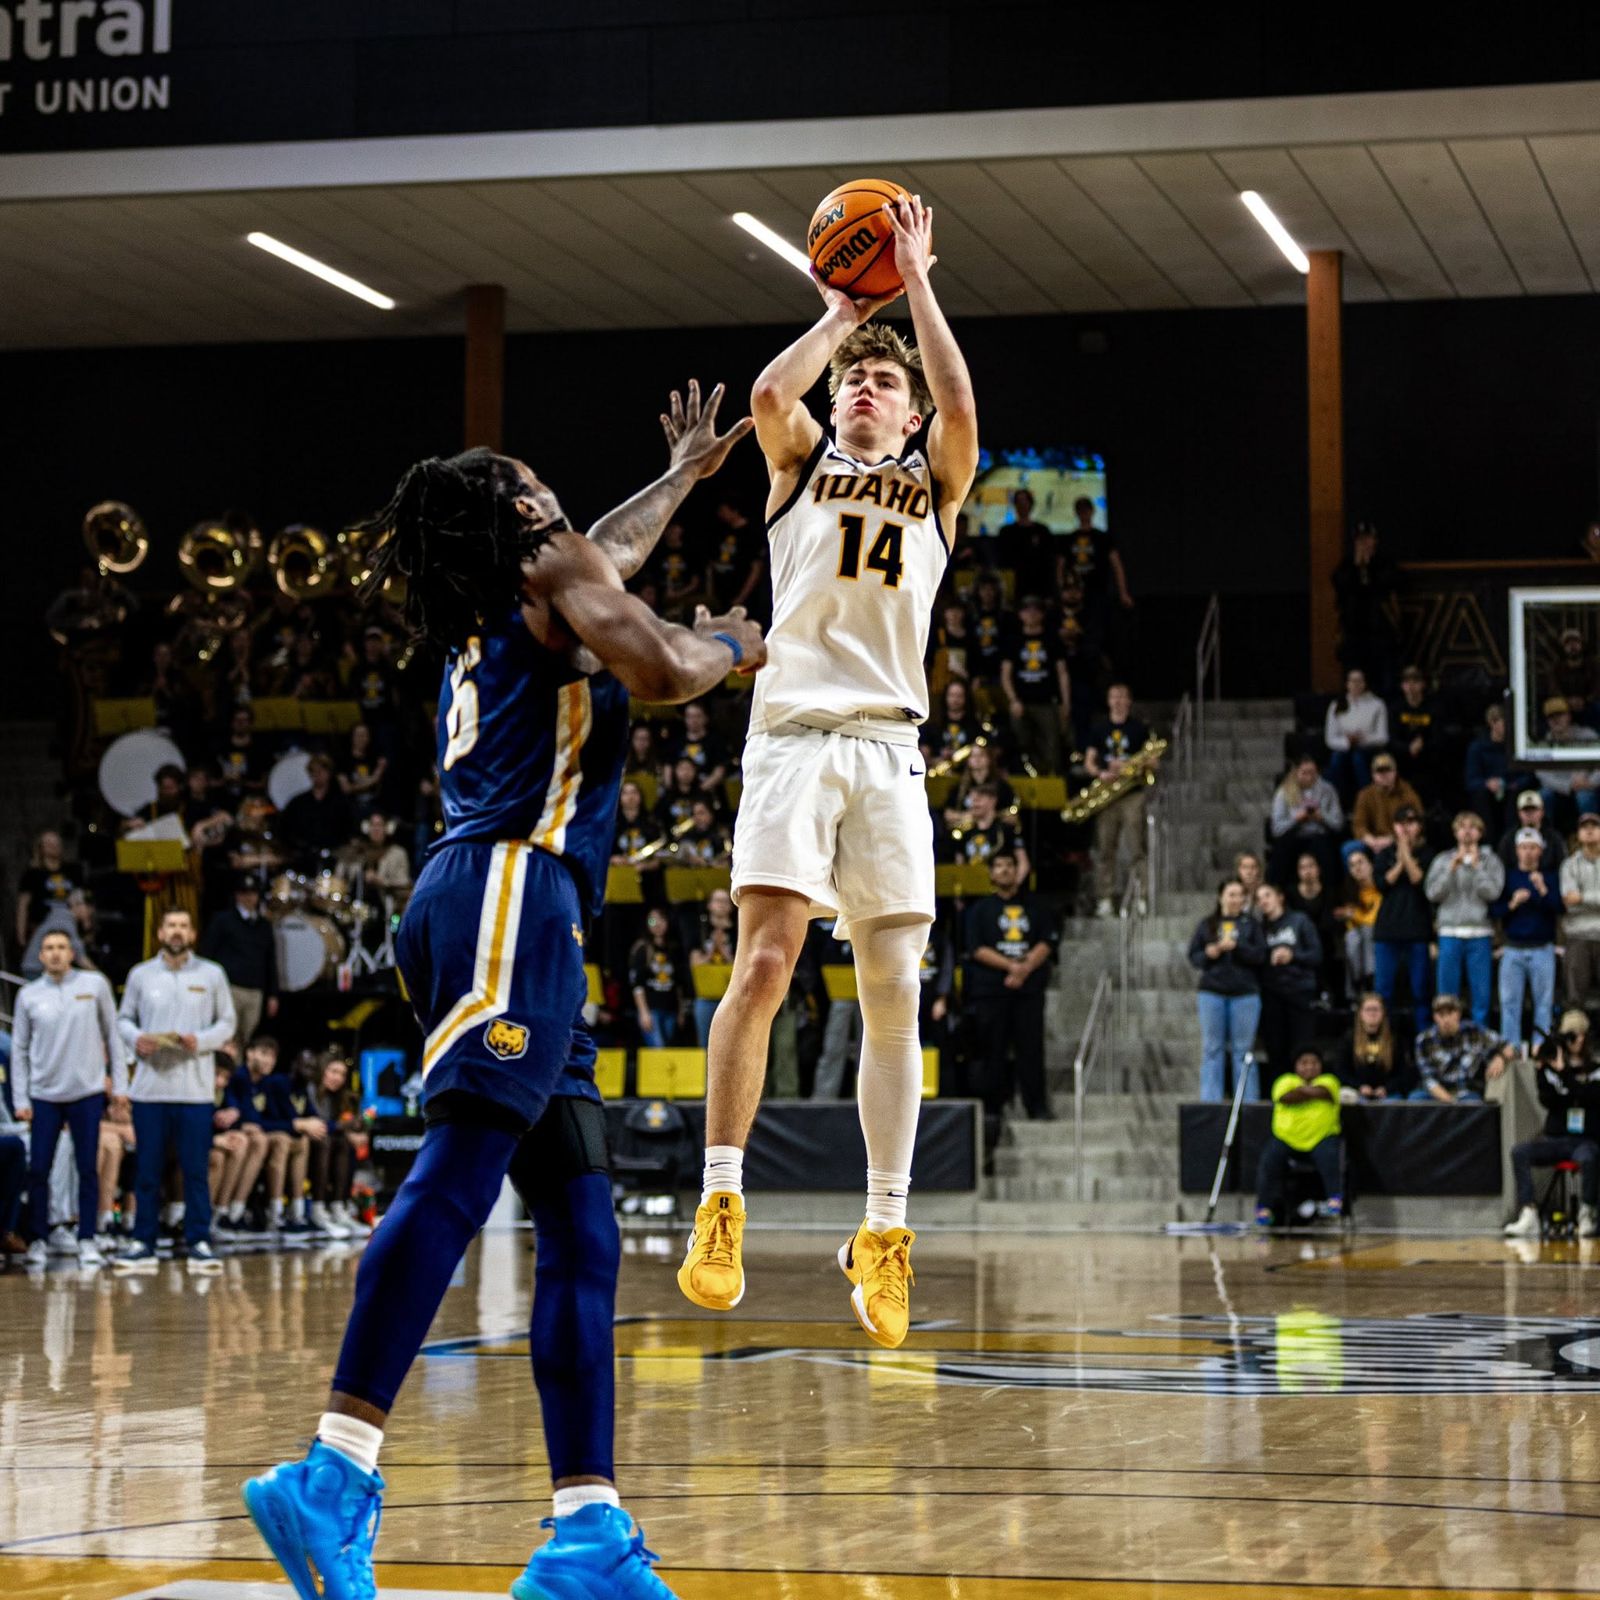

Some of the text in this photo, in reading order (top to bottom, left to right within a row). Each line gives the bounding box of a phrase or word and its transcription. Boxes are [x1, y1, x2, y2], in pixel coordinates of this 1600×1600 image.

[0, 0, 172, 60] tral
[35, 76, 170, 114] UNION
[816, 226, 879, 282] Wilson
[813, 473, 930, 522] IDAHO
[836, 511, 905, 591] 14
